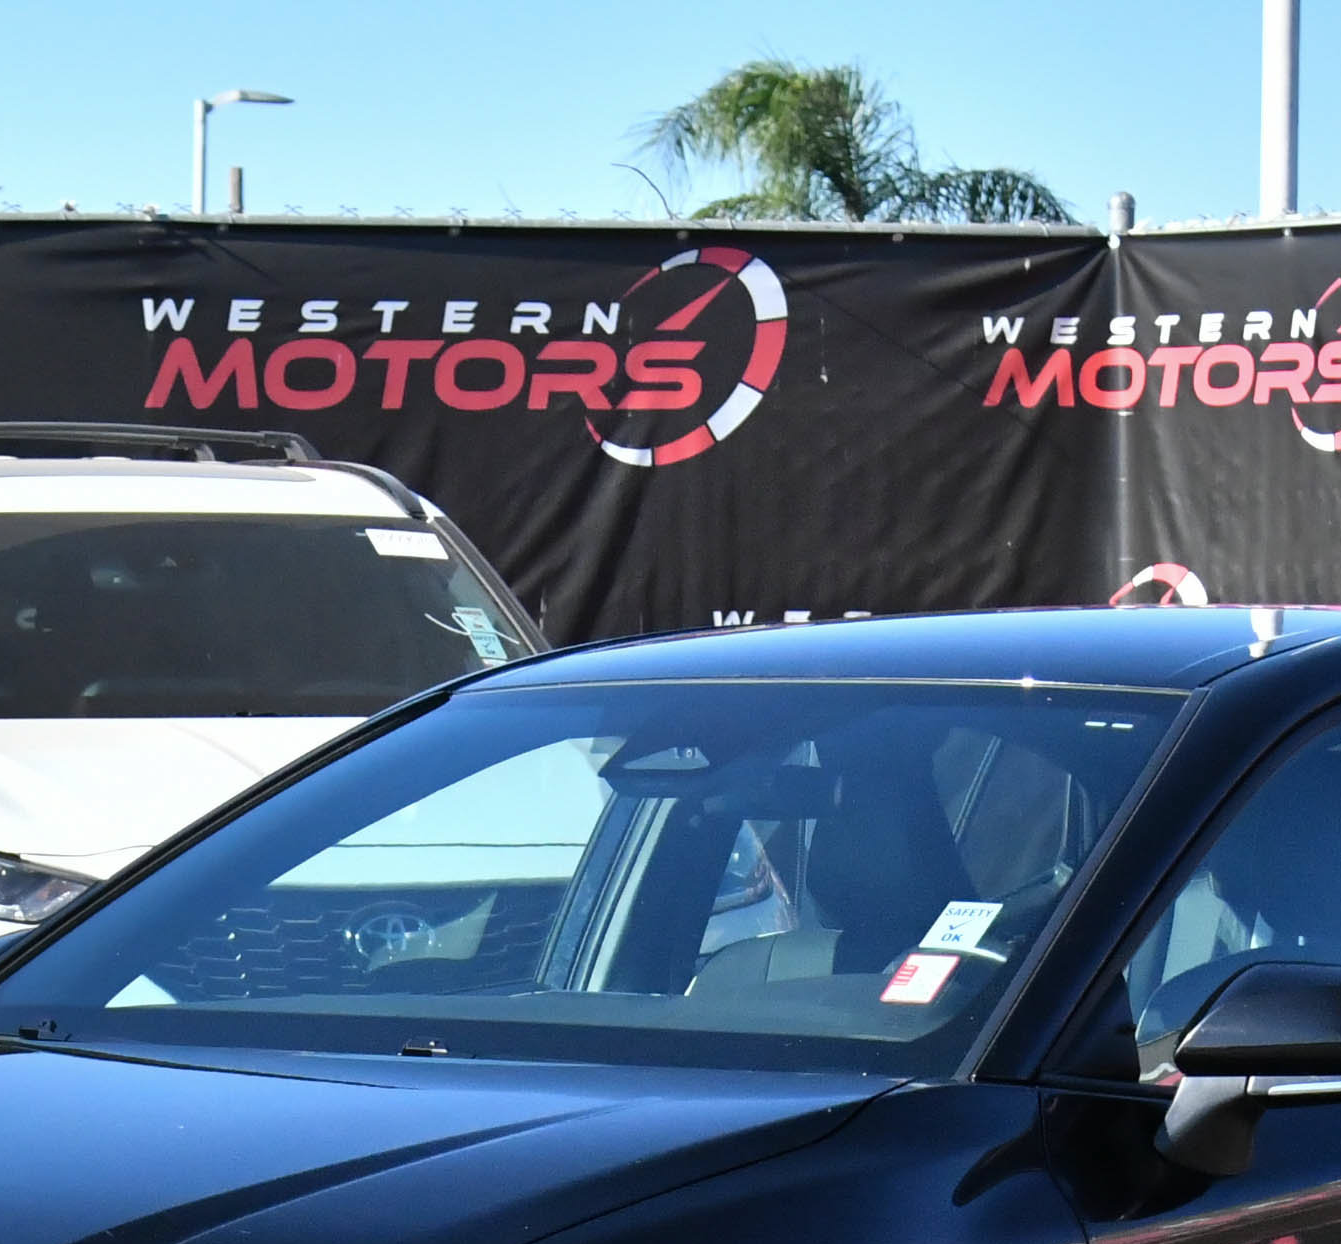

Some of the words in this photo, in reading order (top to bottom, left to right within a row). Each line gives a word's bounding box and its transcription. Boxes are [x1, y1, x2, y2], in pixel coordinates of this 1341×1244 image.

[142, 299, 620, 335] WESTERN
[983, 308, 1318, 345] WESTERN
[144, 338, 706, 411] MOTORS
[945, 907, 994, 918] SAFETY
[941, 932, 964, 942] OK
